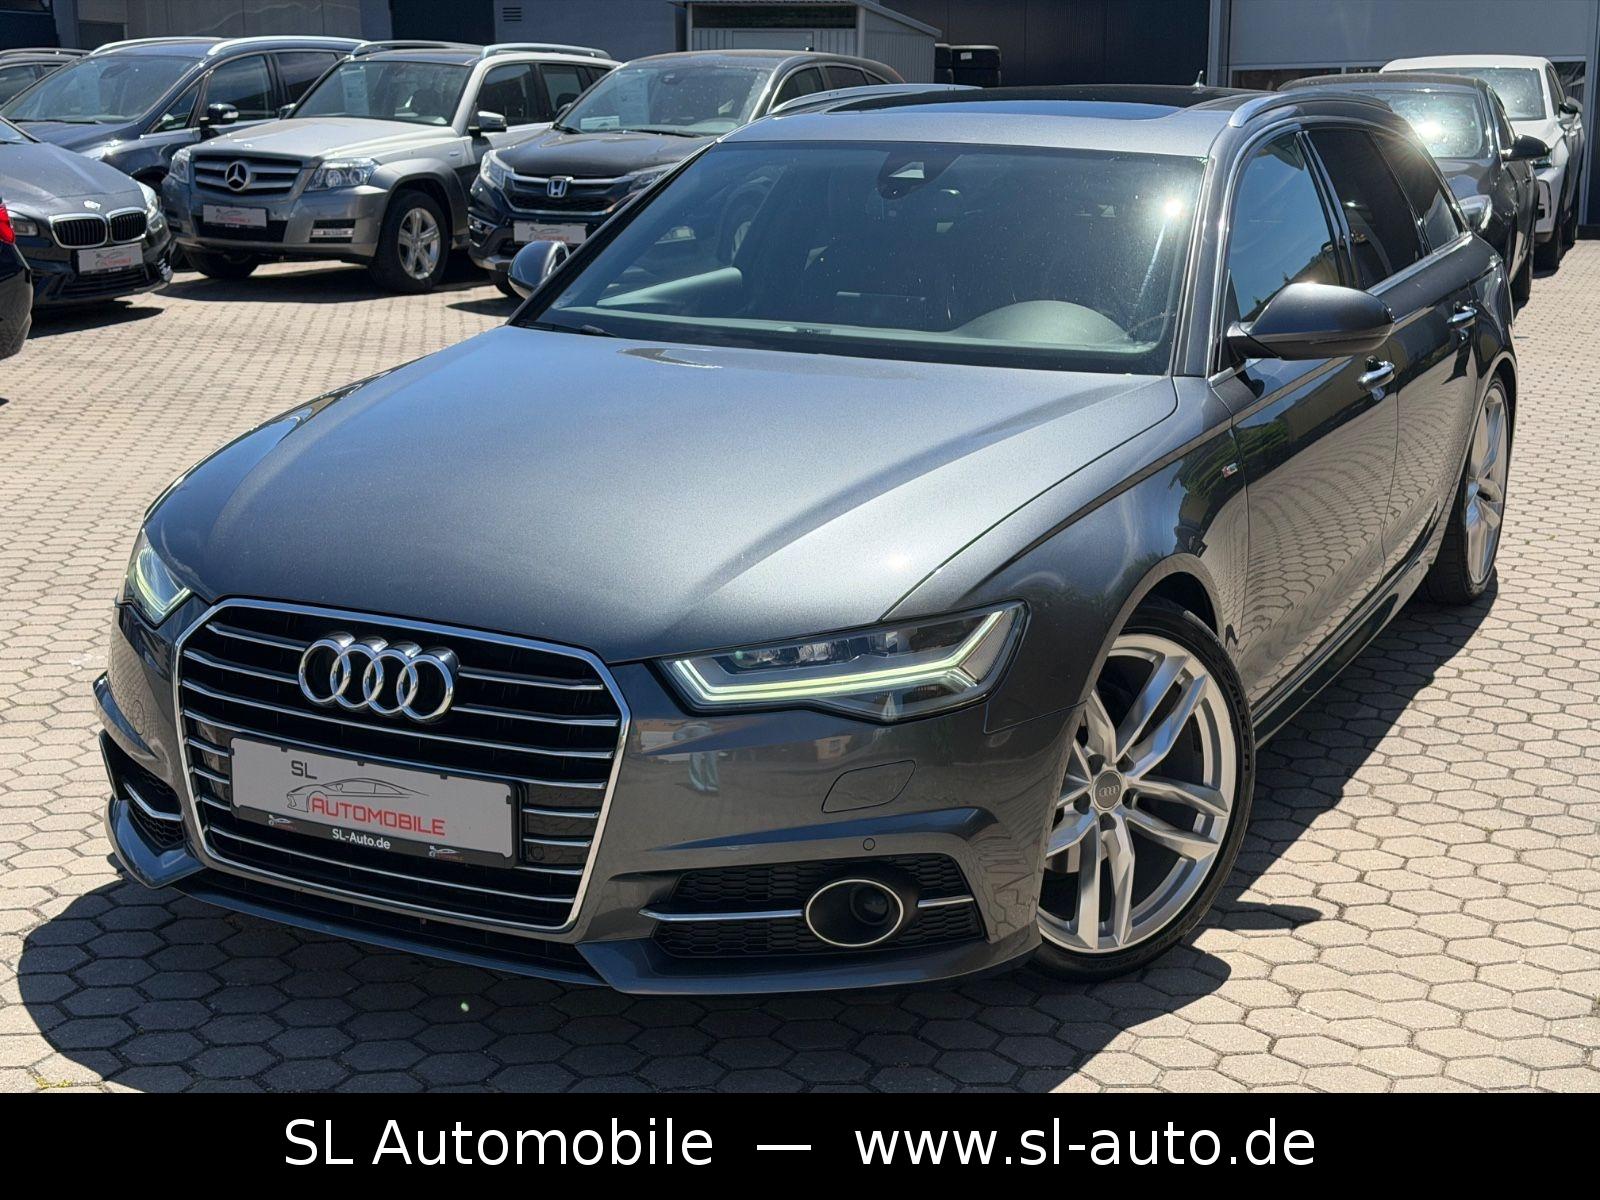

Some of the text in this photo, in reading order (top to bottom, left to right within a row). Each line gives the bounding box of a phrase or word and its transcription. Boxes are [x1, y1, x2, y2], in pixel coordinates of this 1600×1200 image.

[291, 760, 317, 780] SL
[311, 797, 445, 836] AUTOMOBILE
[331, 828, 391, 850] SL-Auto.de
